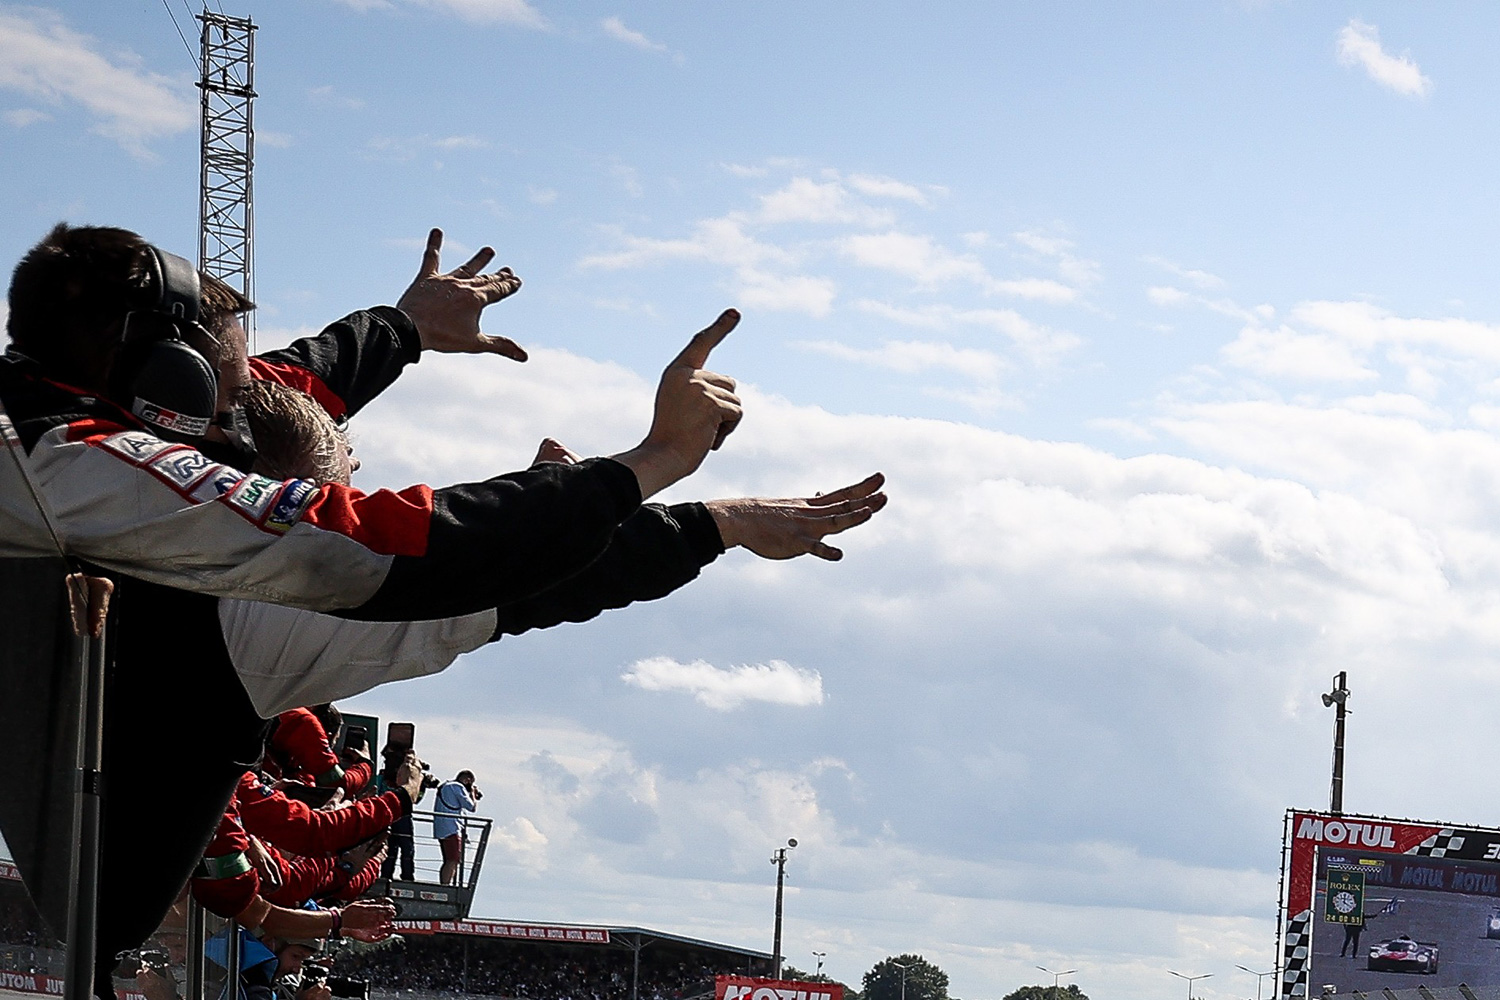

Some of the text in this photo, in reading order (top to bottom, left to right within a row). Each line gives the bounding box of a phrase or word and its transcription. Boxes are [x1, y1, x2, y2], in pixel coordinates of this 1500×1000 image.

[142, 409, 174, 426] GR
[1296, 818, 1396, 848] MOTUL
[1329, 882, 1360, 891] ROLEX
[1401, 866, 1444, 888] MOTUL
[1452, 871, 1498, 893] MOTUL
